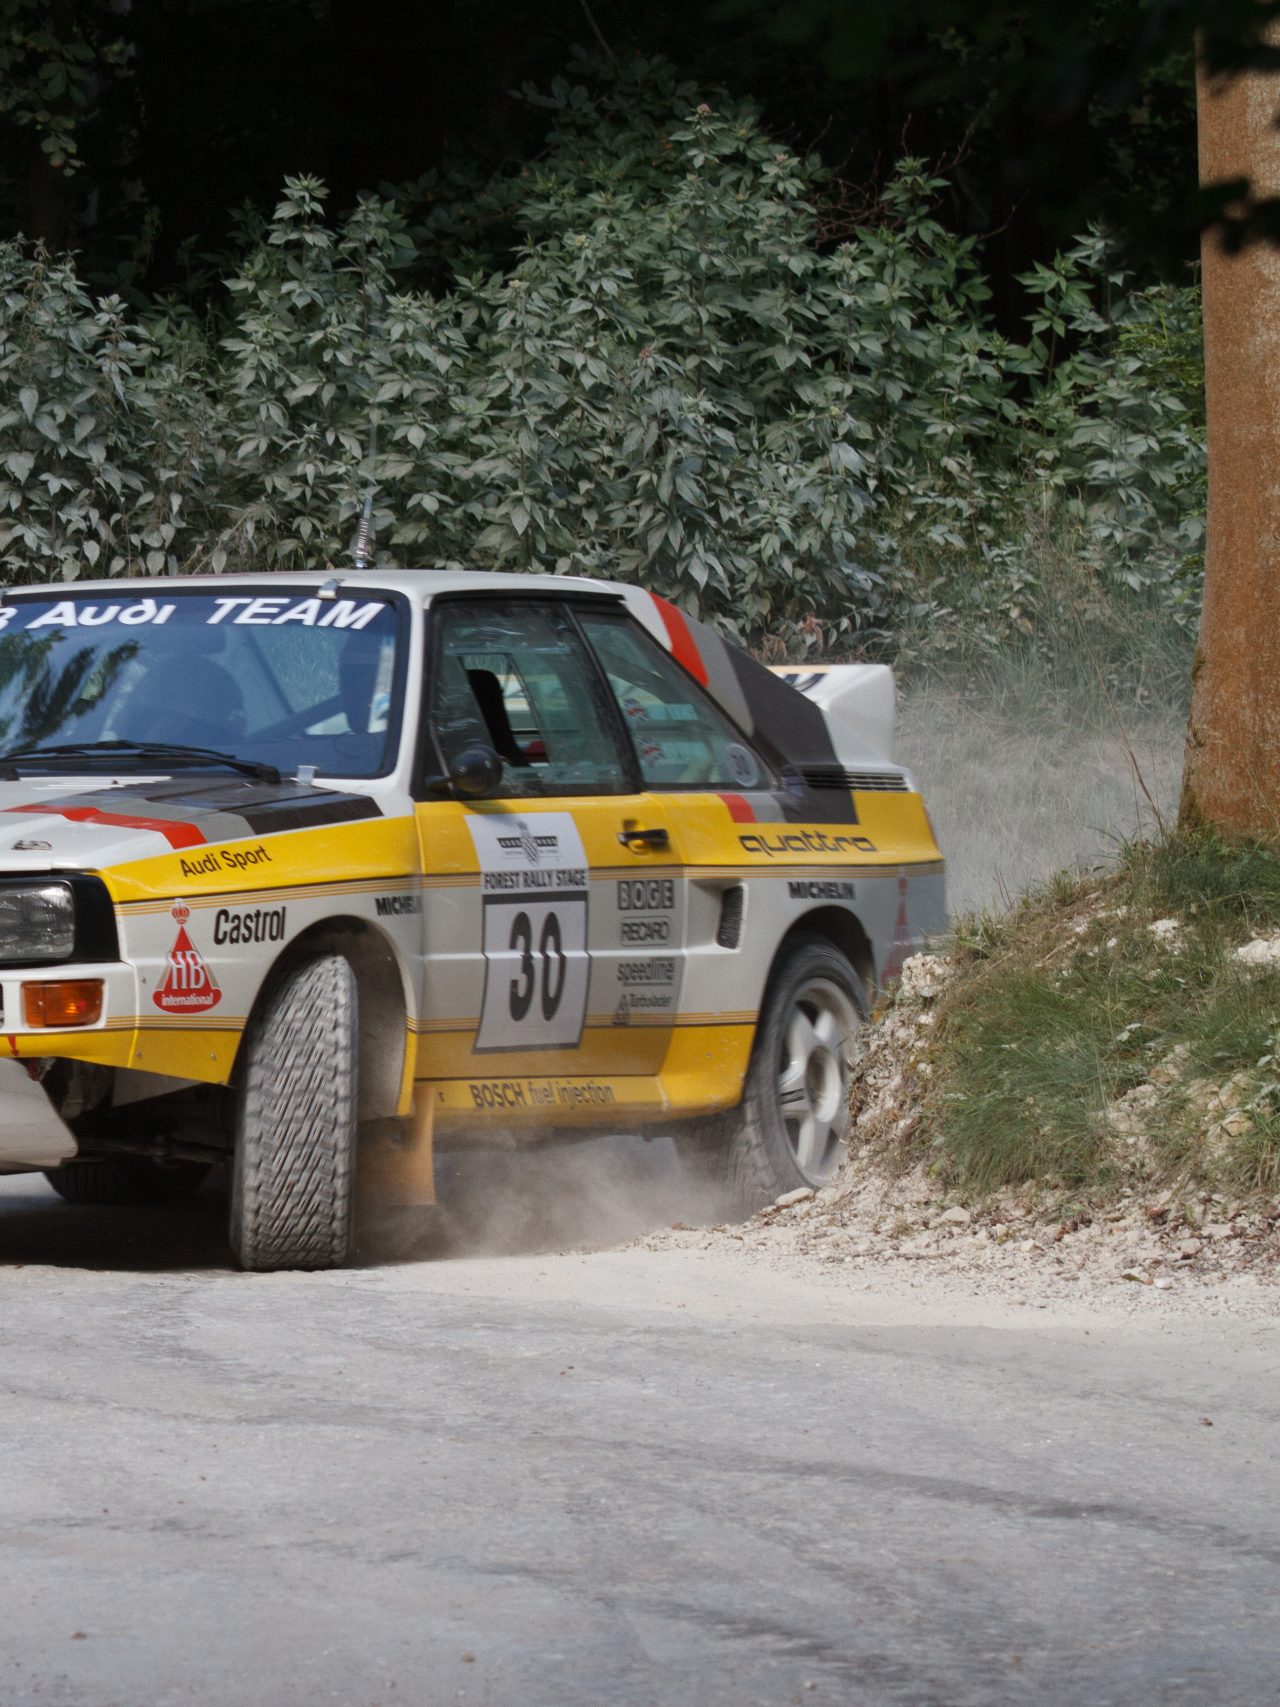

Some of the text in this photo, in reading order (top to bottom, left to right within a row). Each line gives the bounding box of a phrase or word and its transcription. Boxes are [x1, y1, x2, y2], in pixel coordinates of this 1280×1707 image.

[205, 598, 386, 629] TEAM
[738, 830, 878, 857] quattro
[180, 845, 272, 877] Audi Sport
[484, 869, 586, 889] FOREST RALLY STAGE
[787, 881, 856, 900] MICHELIN
[618, 880, 674, 910] BOGE
[213, 906, 286, 945] Castrol
[621, 921, 669, 941] RECARO
[166, 950, 206, 990] HB
[509, 911, 567, 1022] 30
[161, 992, 214, 1007] international
[469, 1081, 616, 1109] BOSCH fuel injection
